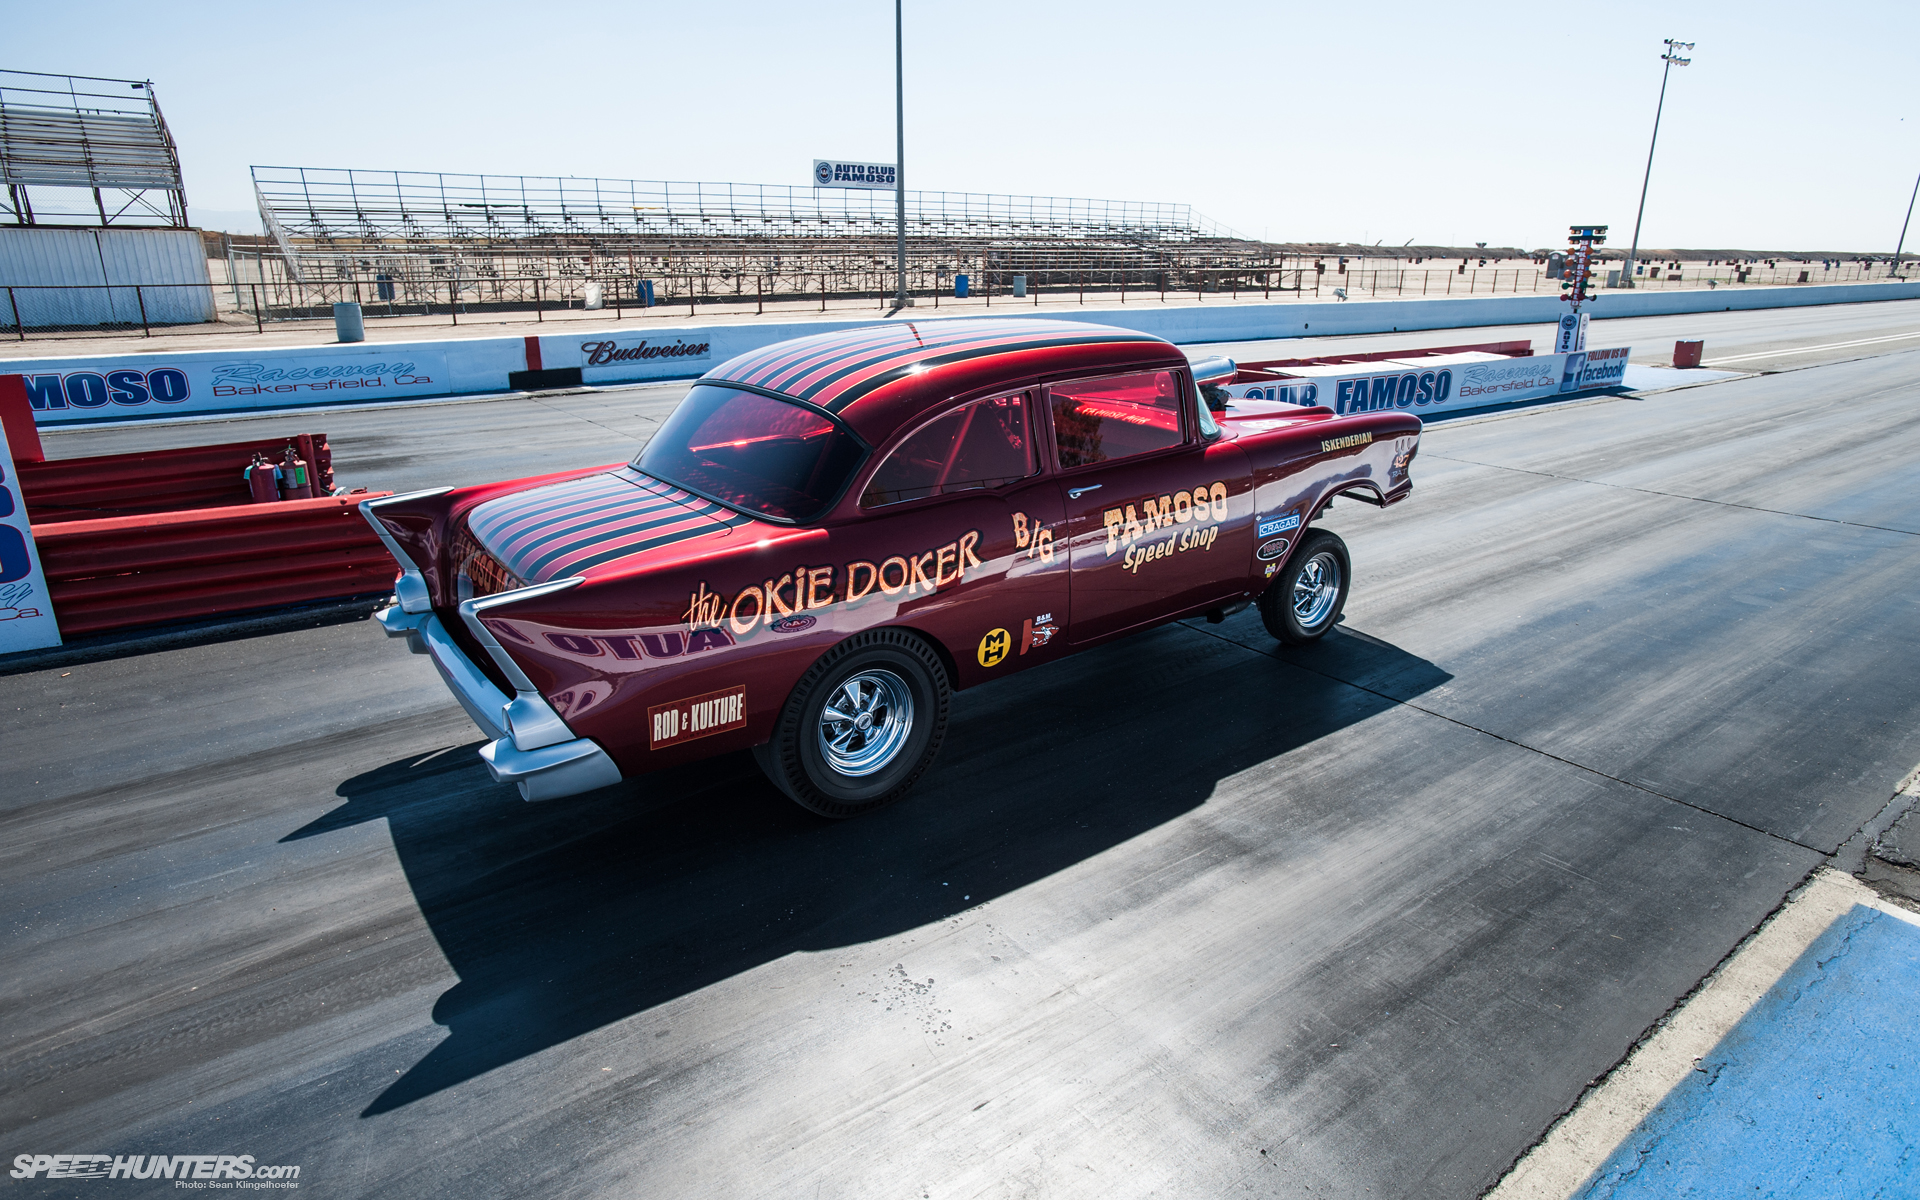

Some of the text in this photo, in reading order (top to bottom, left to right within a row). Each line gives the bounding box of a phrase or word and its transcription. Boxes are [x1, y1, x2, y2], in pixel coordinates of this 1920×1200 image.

[835, 164, 865, 173] AUTO
[868, 166, 895, 175] CLUB
[835, 173, 895, 183] FAMOSO
[1561, 331, 1571, 349] AUTO
[581, 339, 709, 365] Budweiser
[1587, 347, 1629, 361] FOLLOW US ON
[211, 362, 415, 385] Raceway
[1461, 364, 1551, 386] Raceway
[1582, 360, 1624, 381] facebook
[213, 374, 433, 396] Bakersfield, Ca.
[1335, 369, 1452, 416] FAMOSO
[1321, 431, 1373, 452] ISKENDERIAN
[1394, 454, 1410, 468] 427
[1103, 480, 1229, 557] FAMOSO
[1261, 519, 1297, 534] CRAGAR
[1122, 531, 1178, 574] Speed
[1179, 525, 1219, 551] Shop
[682, 582, 727, 631] the
[845, 530, 981, 603] DOKER
[1036, 613, 1051, 622] B&M
[653, 687, 743, 712] TRADITIONAL
[654, 693, 743, 742] ROD & KULTURE
[670, 725, 728, 743] ILLUSTRATED
